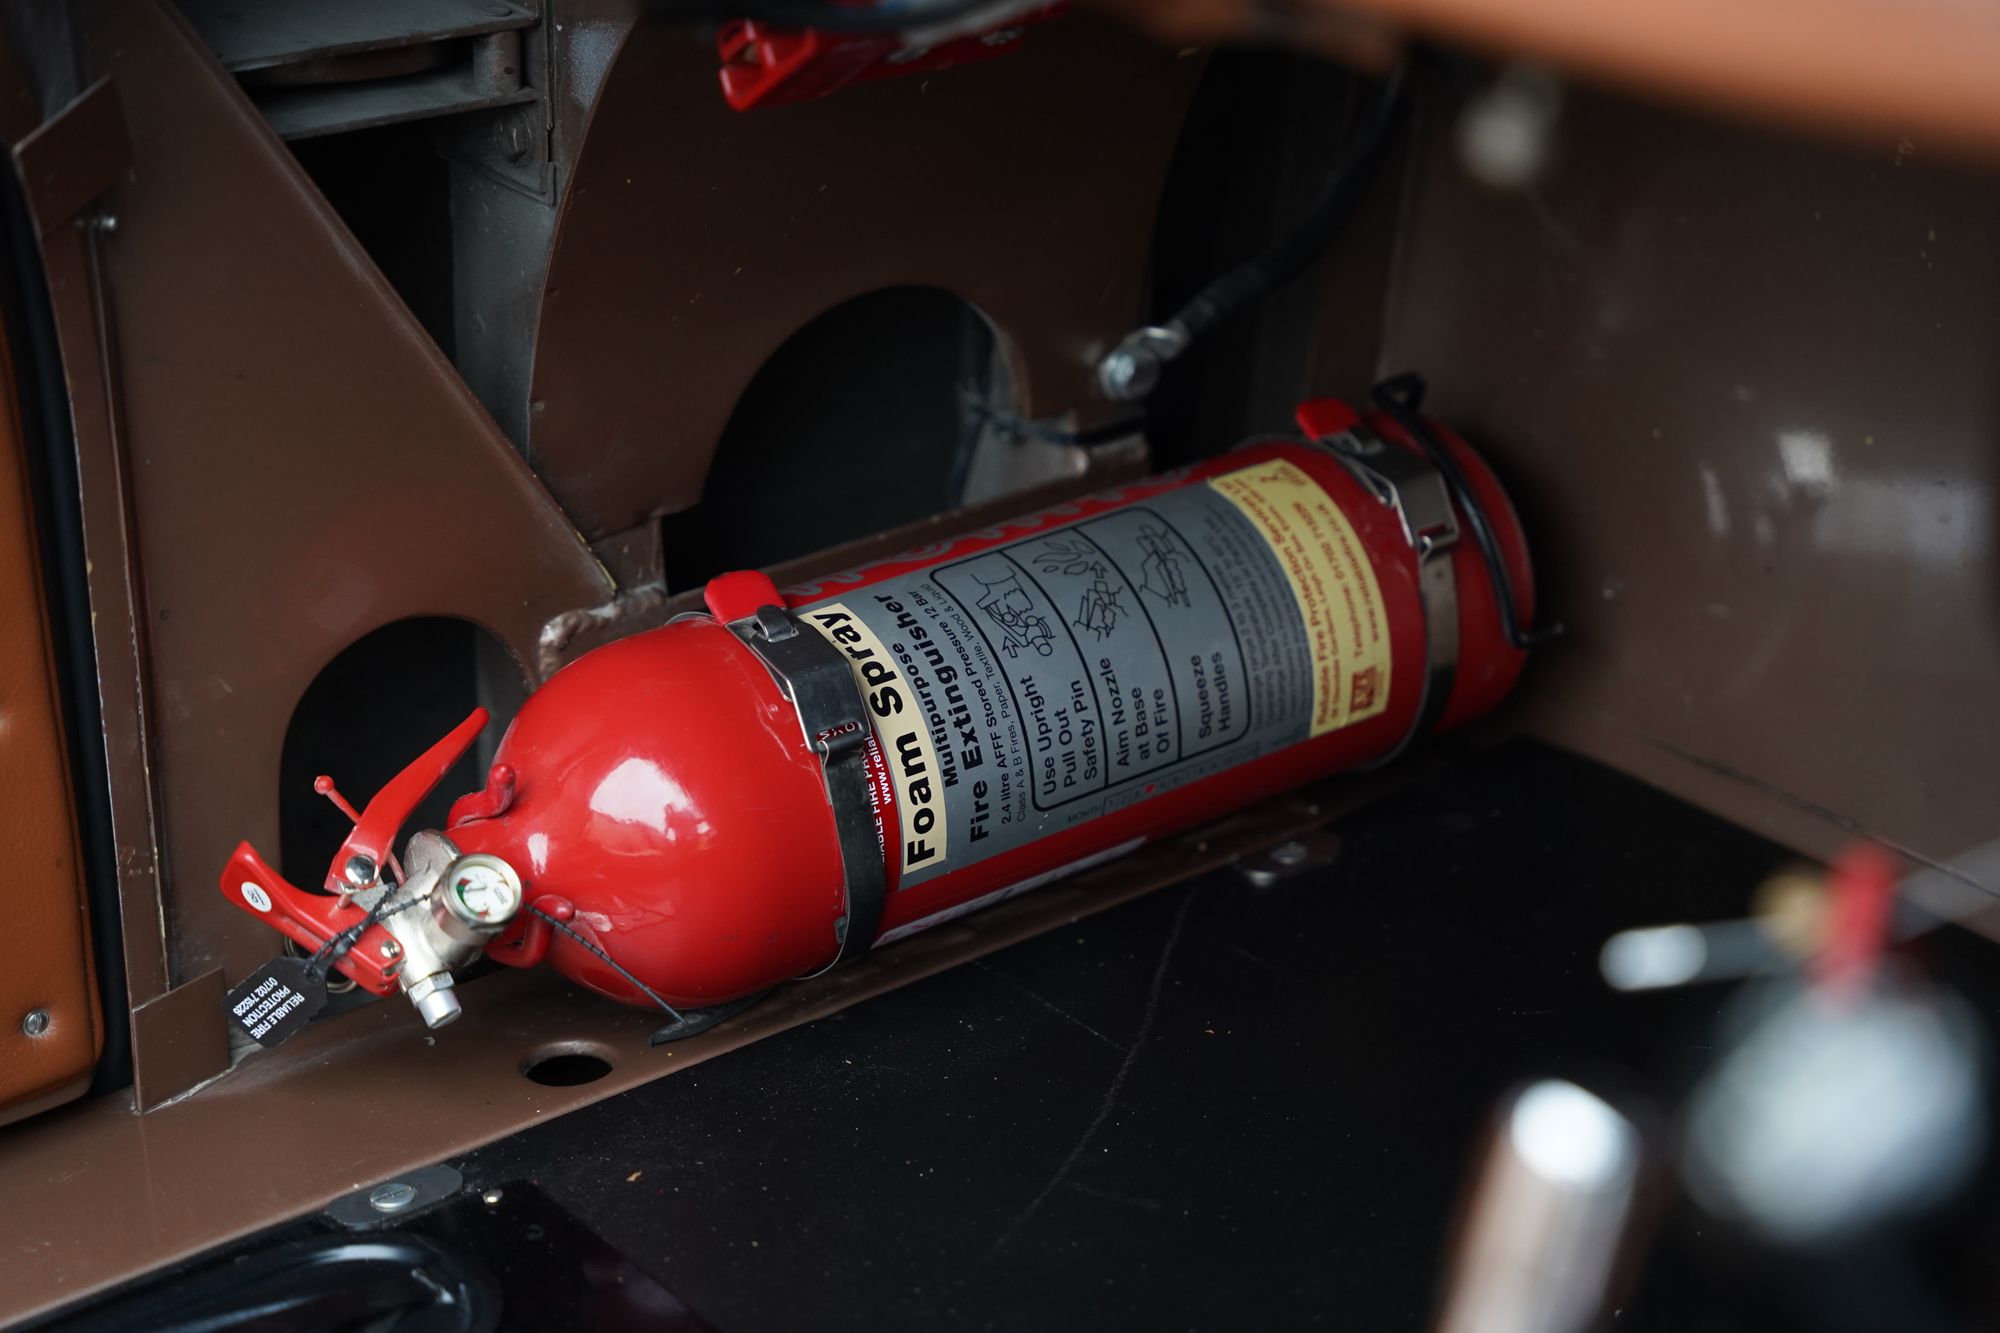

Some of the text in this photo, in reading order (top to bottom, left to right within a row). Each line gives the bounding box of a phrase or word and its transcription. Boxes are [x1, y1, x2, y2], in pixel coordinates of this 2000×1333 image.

[1280, 545, 1323, 628] Protection
[949, 613, 975, 642] Wood
[1313, 629, 1329, 663] Fire
[812, 613, 903, 717] Spray
[874, 595, 983, 770] Extinguisher
[974, 642, 995, 681] Textile,
[1211, 651, 1231, 732] Handles
[892, 643, 959, 788] Multipurpose
[908, 591, 1012, 825] 2.4 litre AFFF Stored Pressure 12 Bar
[993, 681, 1011, 719] Paper,
[1071, 680, 1098, 780] Safety Pin
[1099, 658, 1130, 767] Aim Nozzle
[1131, 687, 1150, 760] at Base
[1153, 688, 1170, 754] Of Fire
[1190, 655, 1214, 739] Squeeze
[1007, 721, 1021, 754] Fires,
[1013, 756, 1023, 766] B
[1020, 675, 1057, 796] Use Upright
[1054, 707, 1077, 788] Pull Out
[896, 731, 935, 866] Foam
[1015, 768, 1024, 777] &
[1016, 779, 1025, 788] A
[970, 780, 989, 843] Fire
[1016, 791, 1026, 823] Class
[232, 976, 278, 1017] 01702 715226
[241, 984, 291, 1028] PROTECTION
[249, 991, 306, 1040] RELIABLE FIRE
